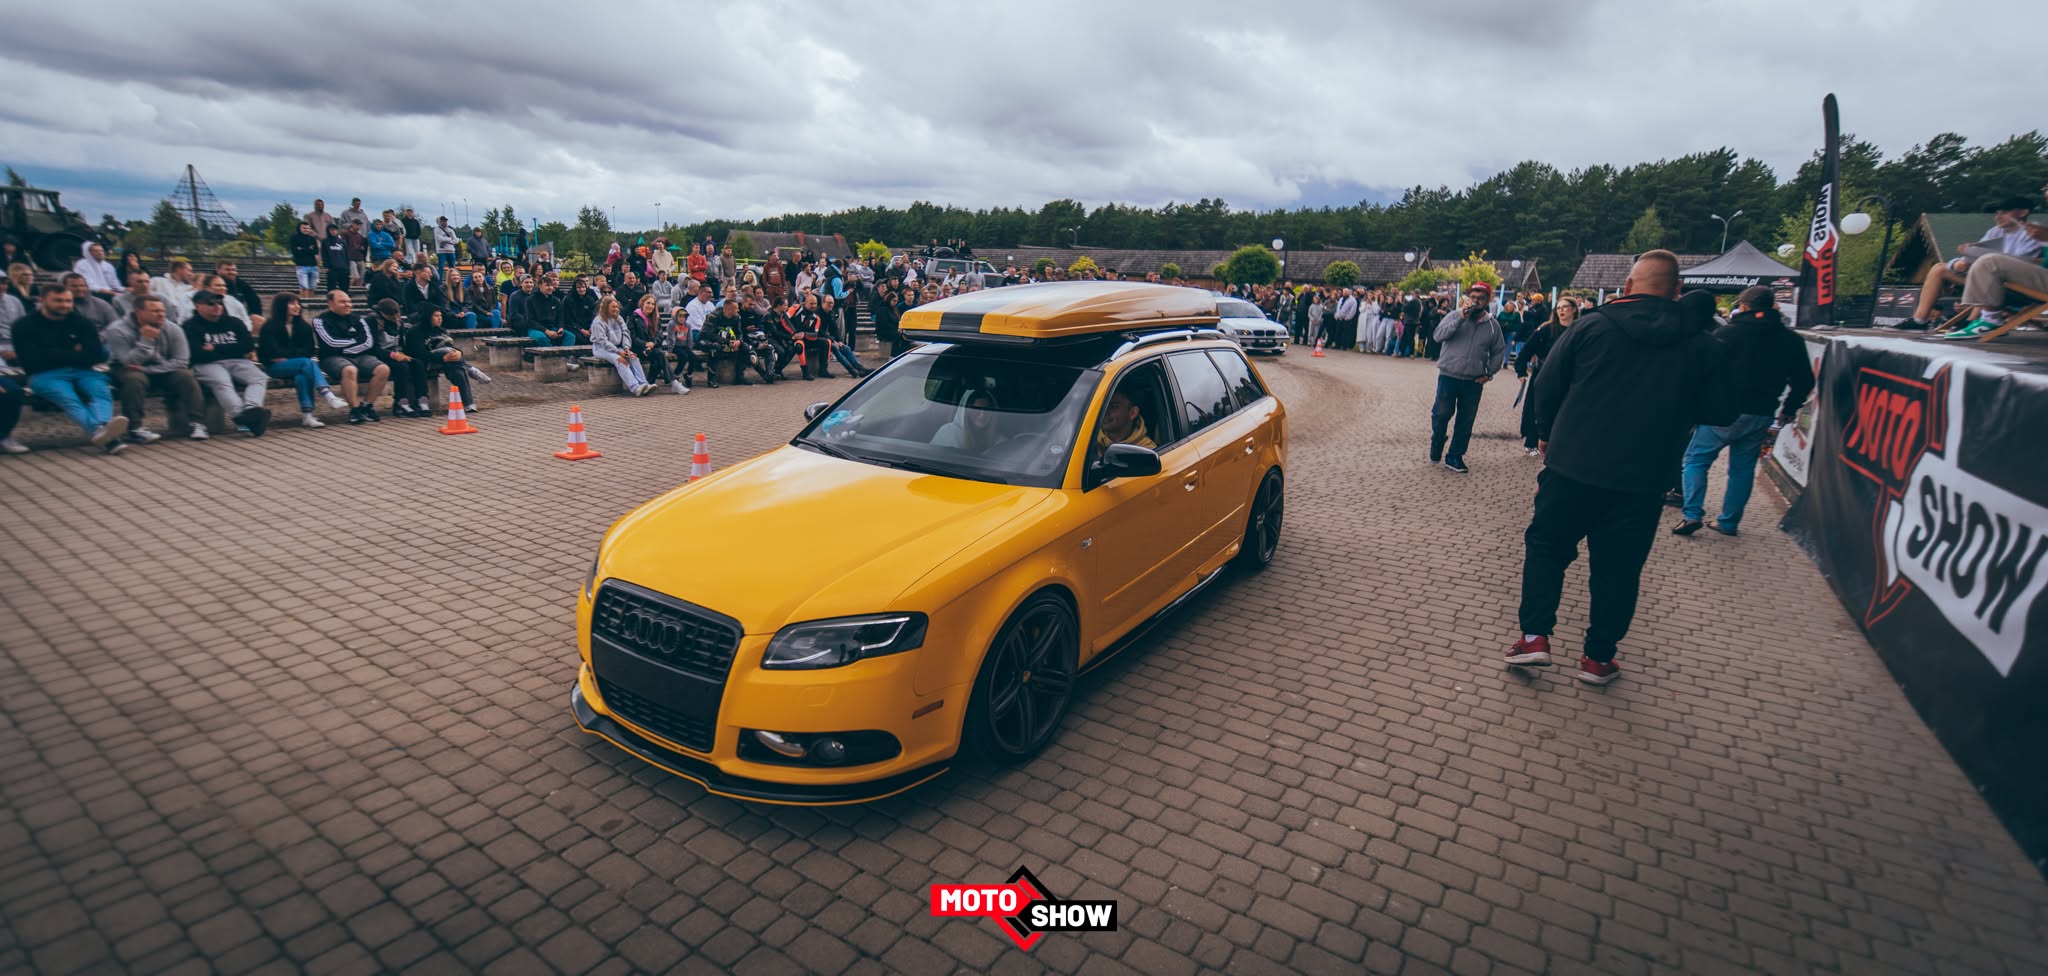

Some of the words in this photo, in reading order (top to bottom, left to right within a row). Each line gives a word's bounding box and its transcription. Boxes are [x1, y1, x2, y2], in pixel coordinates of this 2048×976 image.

[1684, 276, 1760, 287] www.serwishub.pl
[1847, 383, 1922, 480] MOTO
[1907, 475, 2048, 635] SHOW
